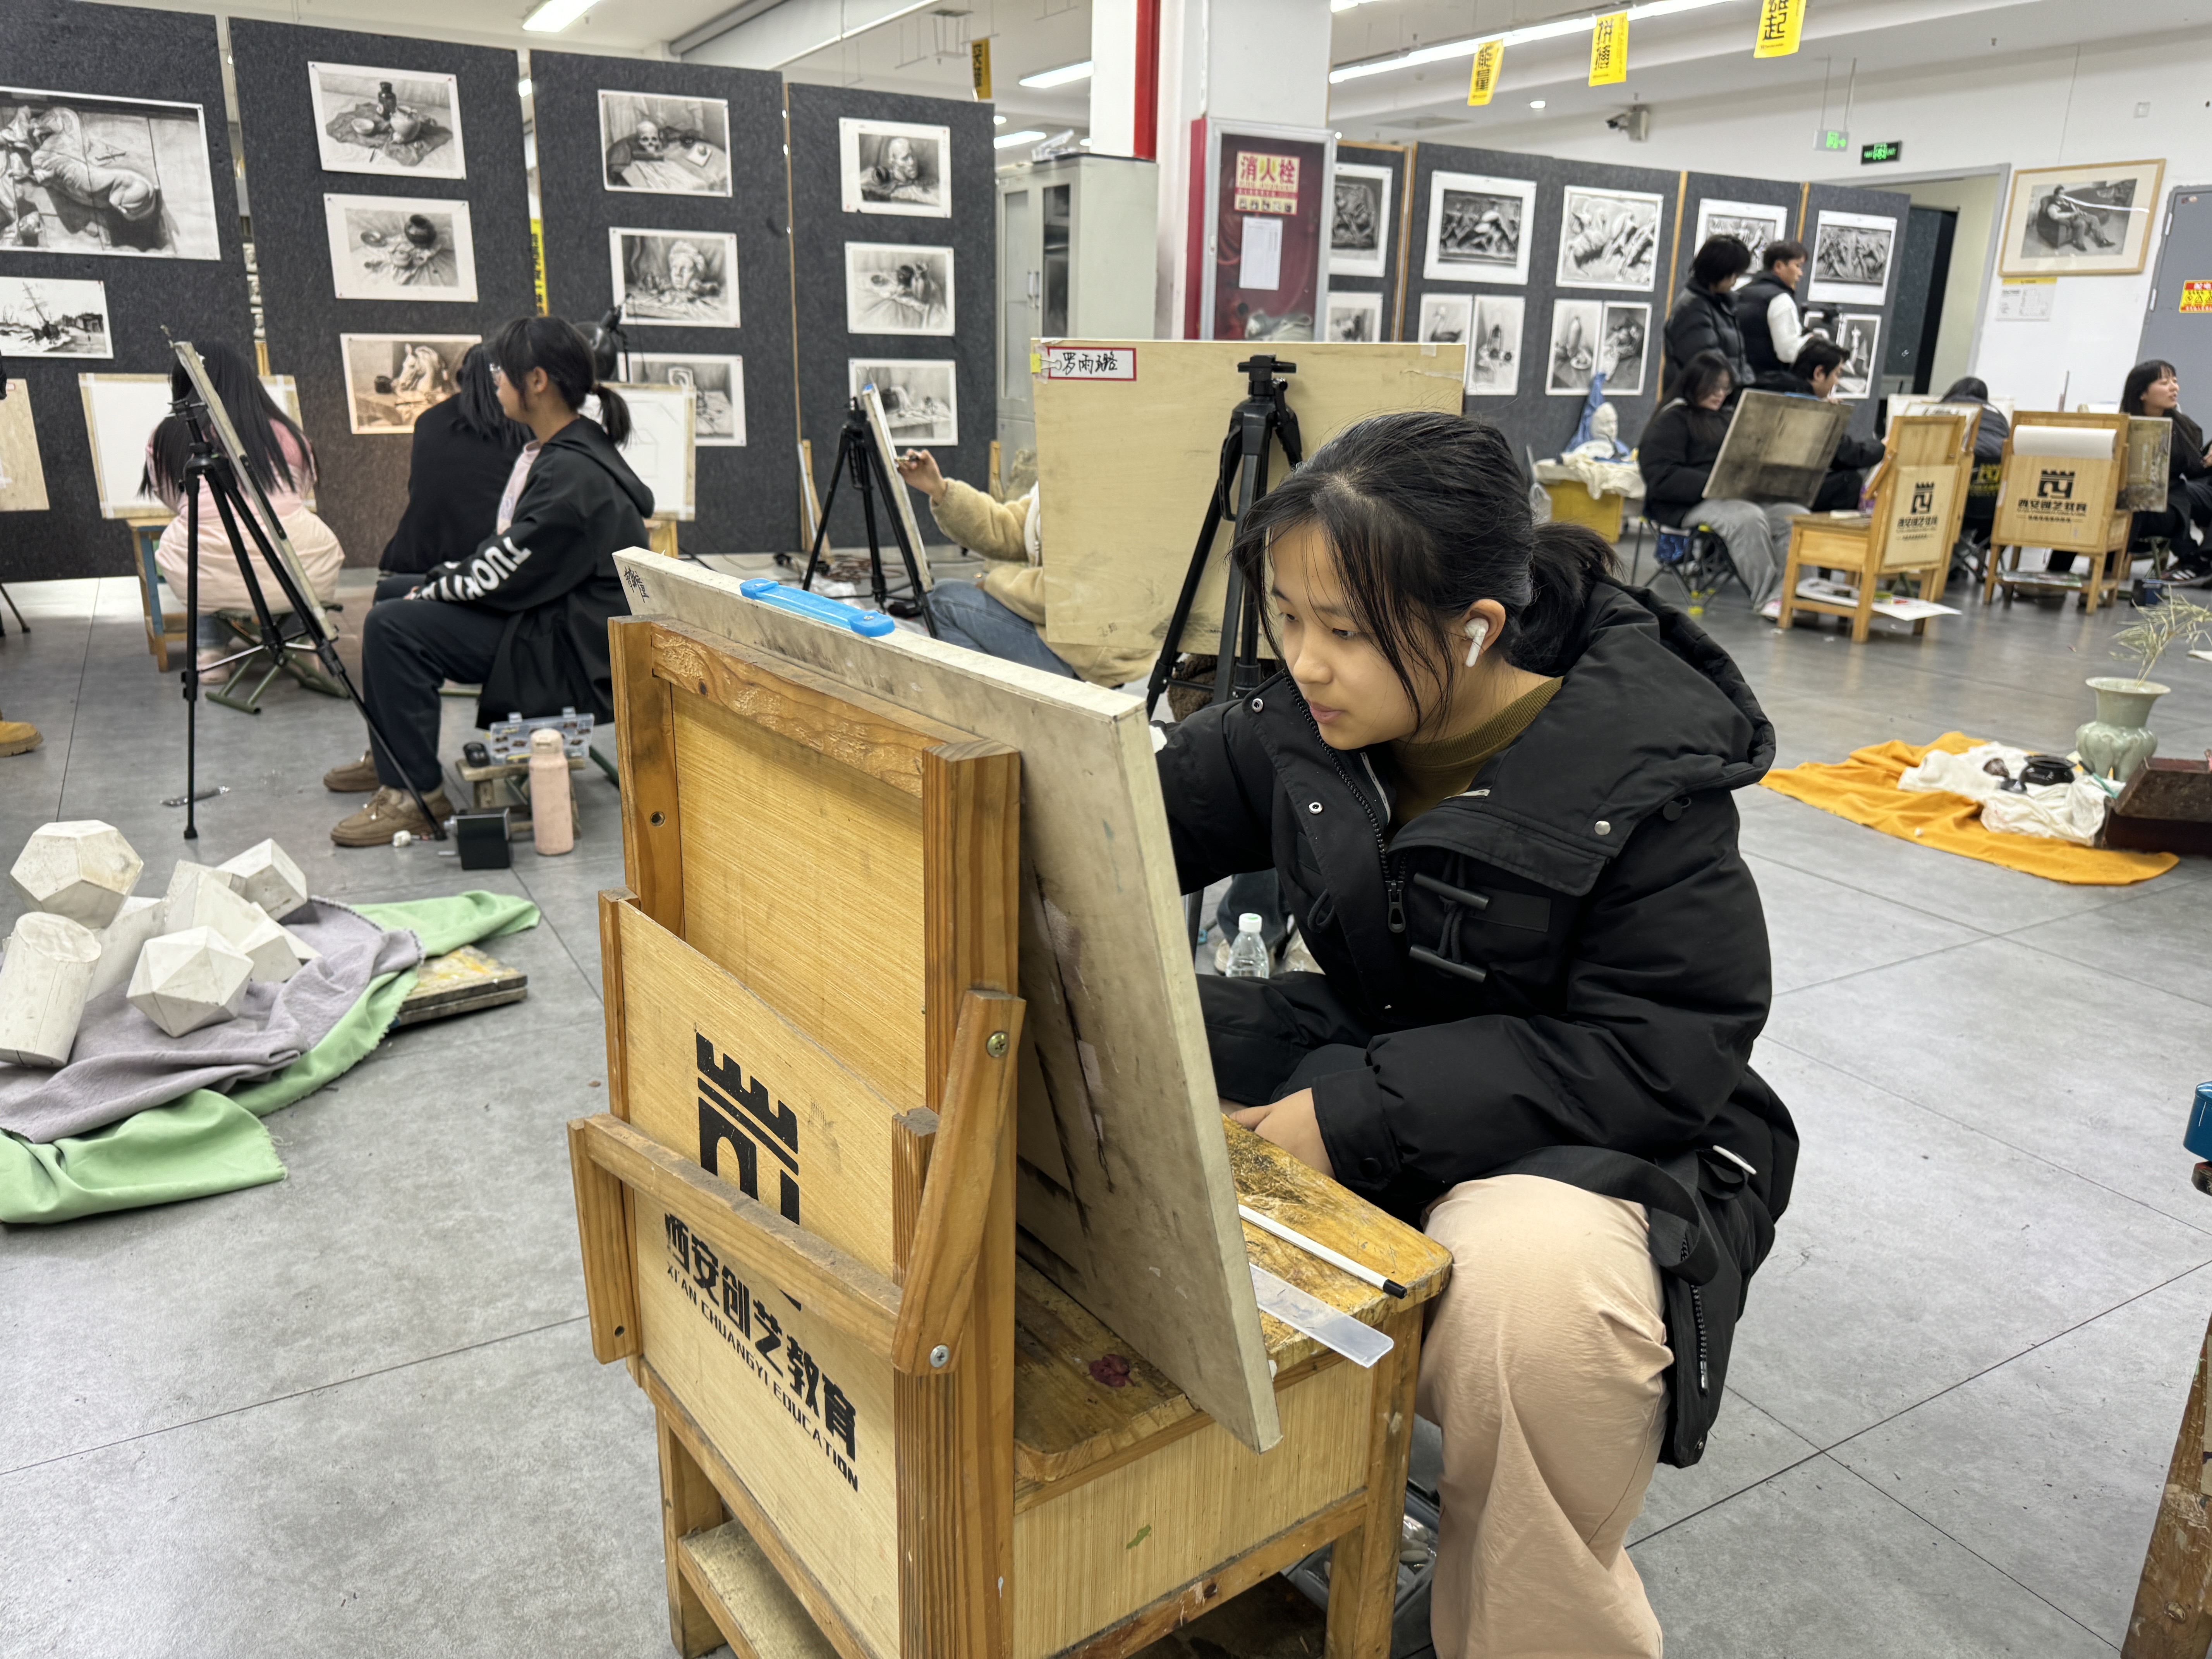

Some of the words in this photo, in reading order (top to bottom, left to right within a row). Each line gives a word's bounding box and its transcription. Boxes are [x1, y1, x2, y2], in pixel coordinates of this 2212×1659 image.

[665, 1212, 855, 1462] 西安创艺教育
[667, 1261, 697, 1307] XI'AN
[701, 1302, 769, 1386] CHUANGYI
[773, 1385, 858, 1492] EDUCATION
